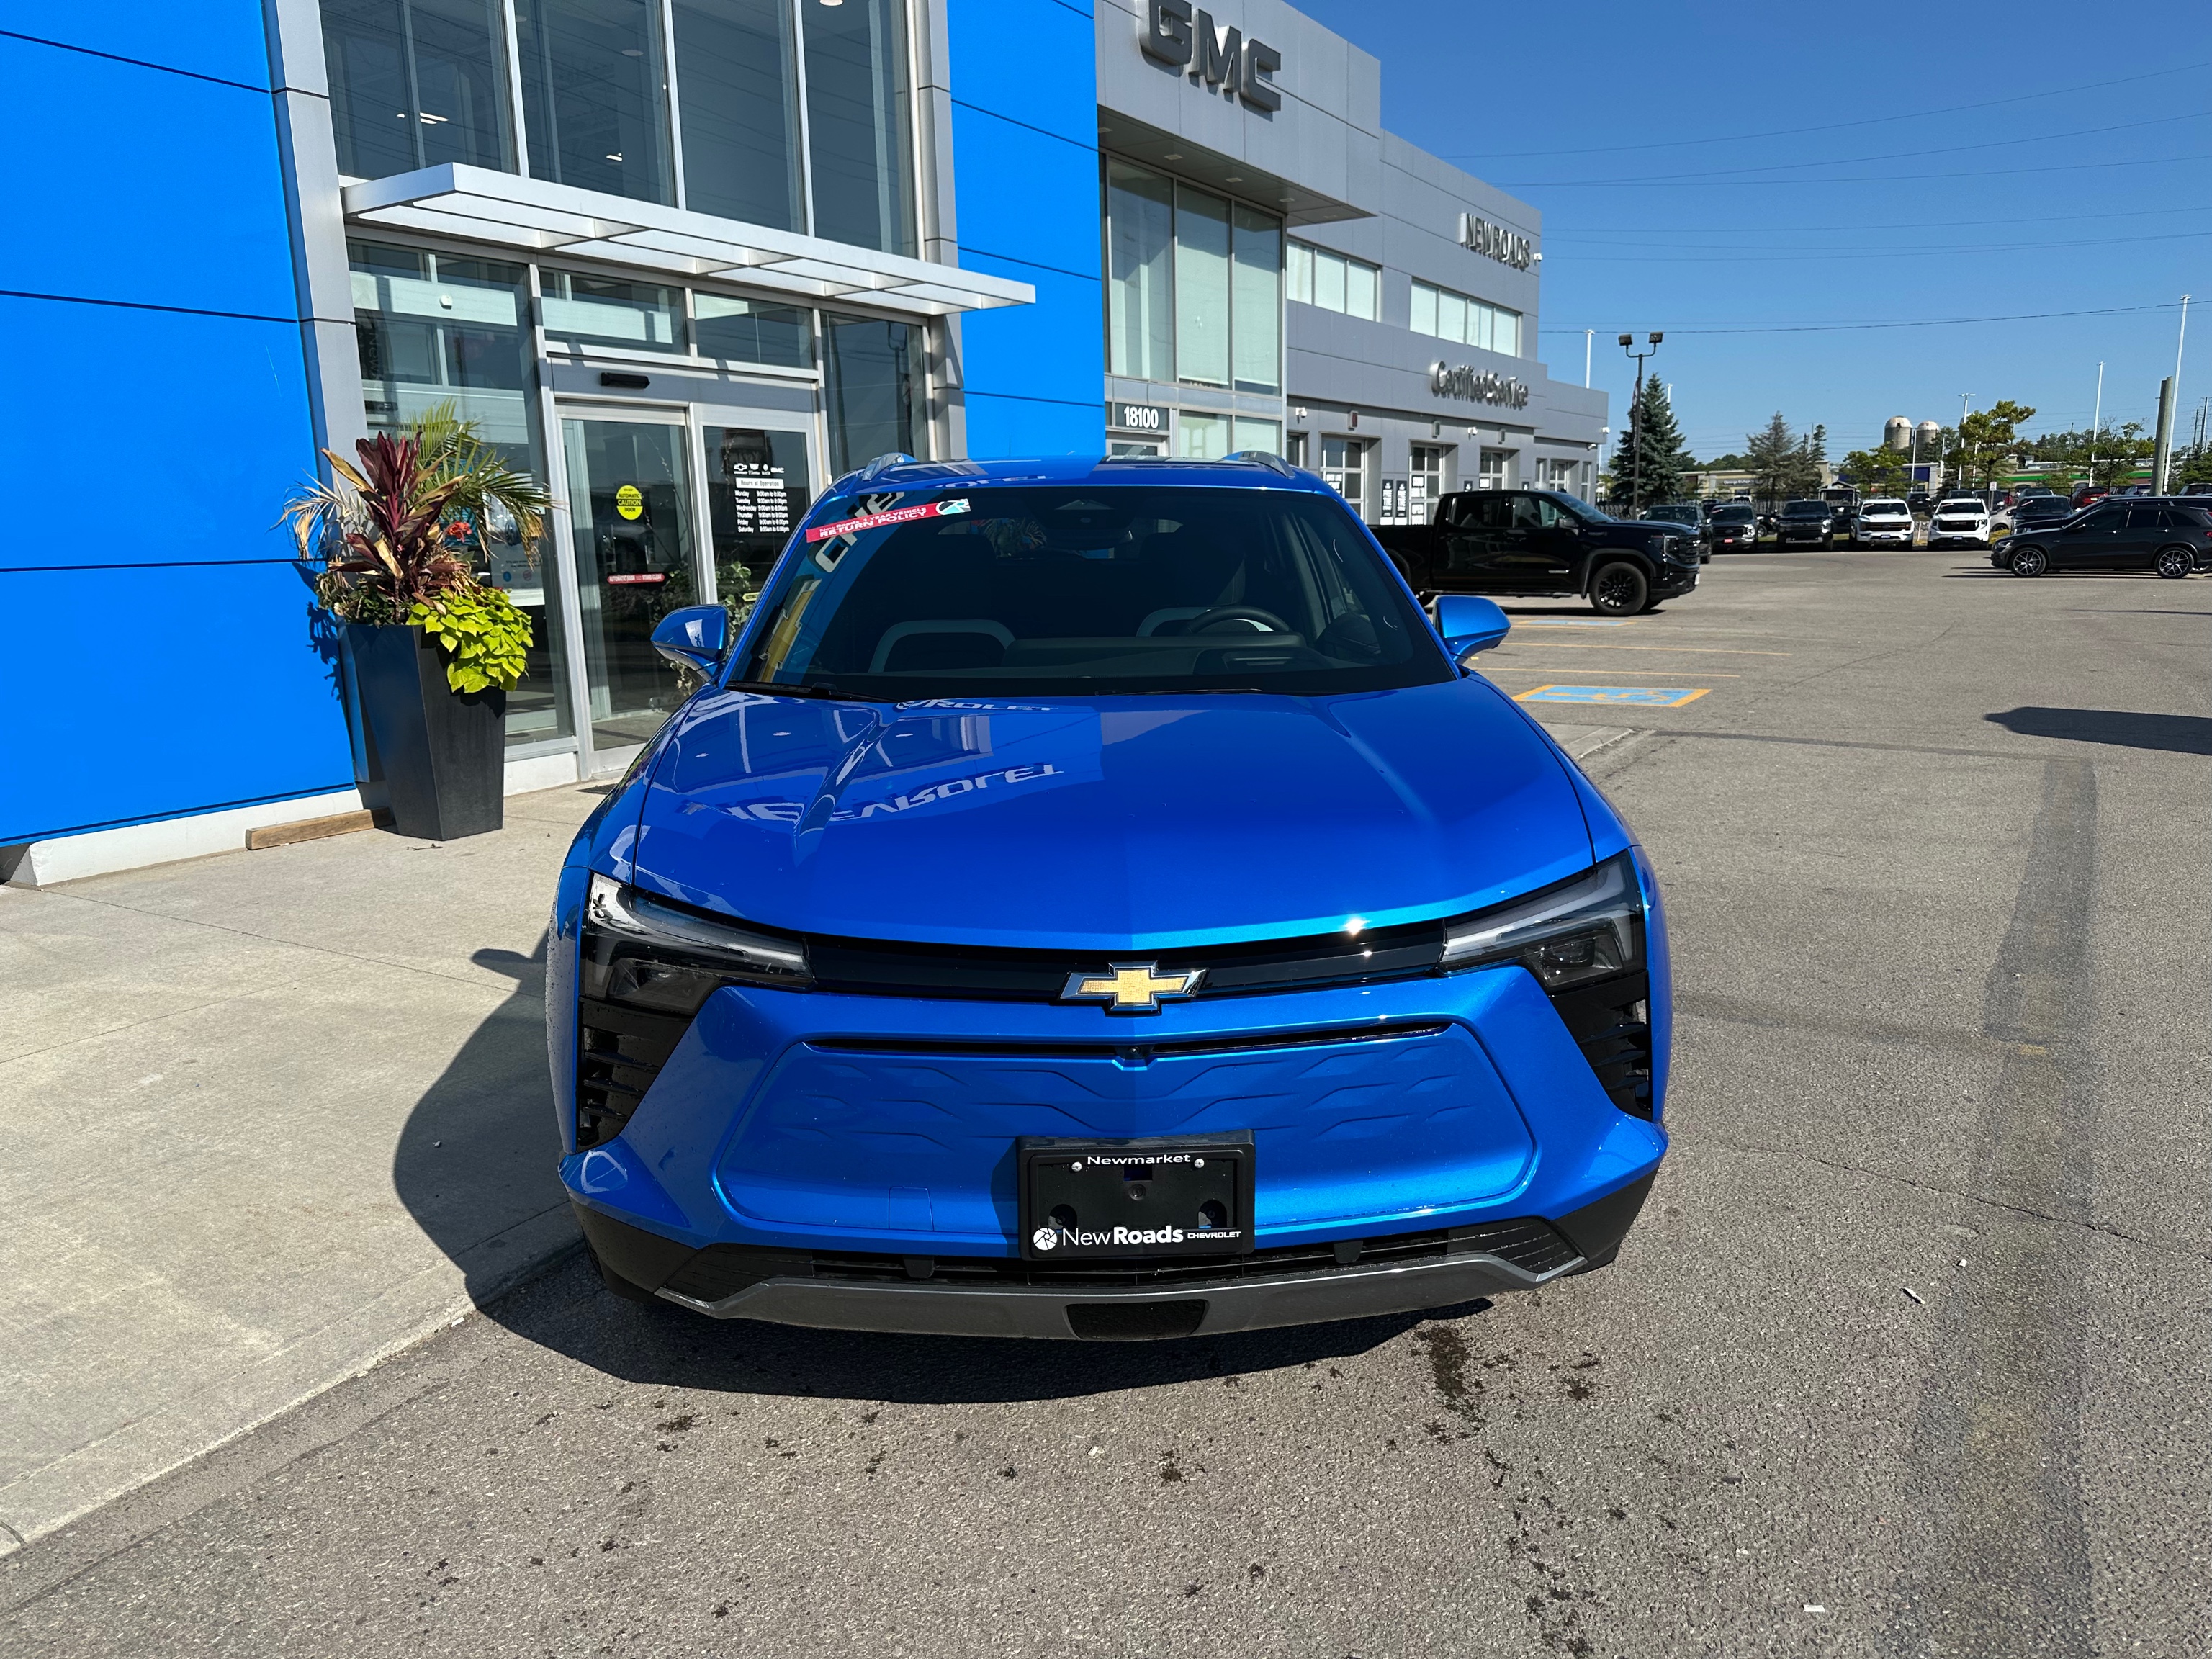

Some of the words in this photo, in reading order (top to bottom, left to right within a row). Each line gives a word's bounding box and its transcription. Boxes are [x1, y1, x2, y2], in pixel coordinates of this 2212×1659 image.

[1138, 0, 1281, 112] GMC
[1124, 406, 1159, 429] 18100
[893, 507, 927, 516] VEHICLE
[819, 519, 874, 537] RETURN
[878, 511, 927, 524] POLICY
[1087, 1154, 1191, 1165] Newmarket
[1062, 1227, 1111, 1246] New
[1113, 1226, 1184, 1245] Roads
[1187, 1231, 1241, 1239] CHEVROLET
